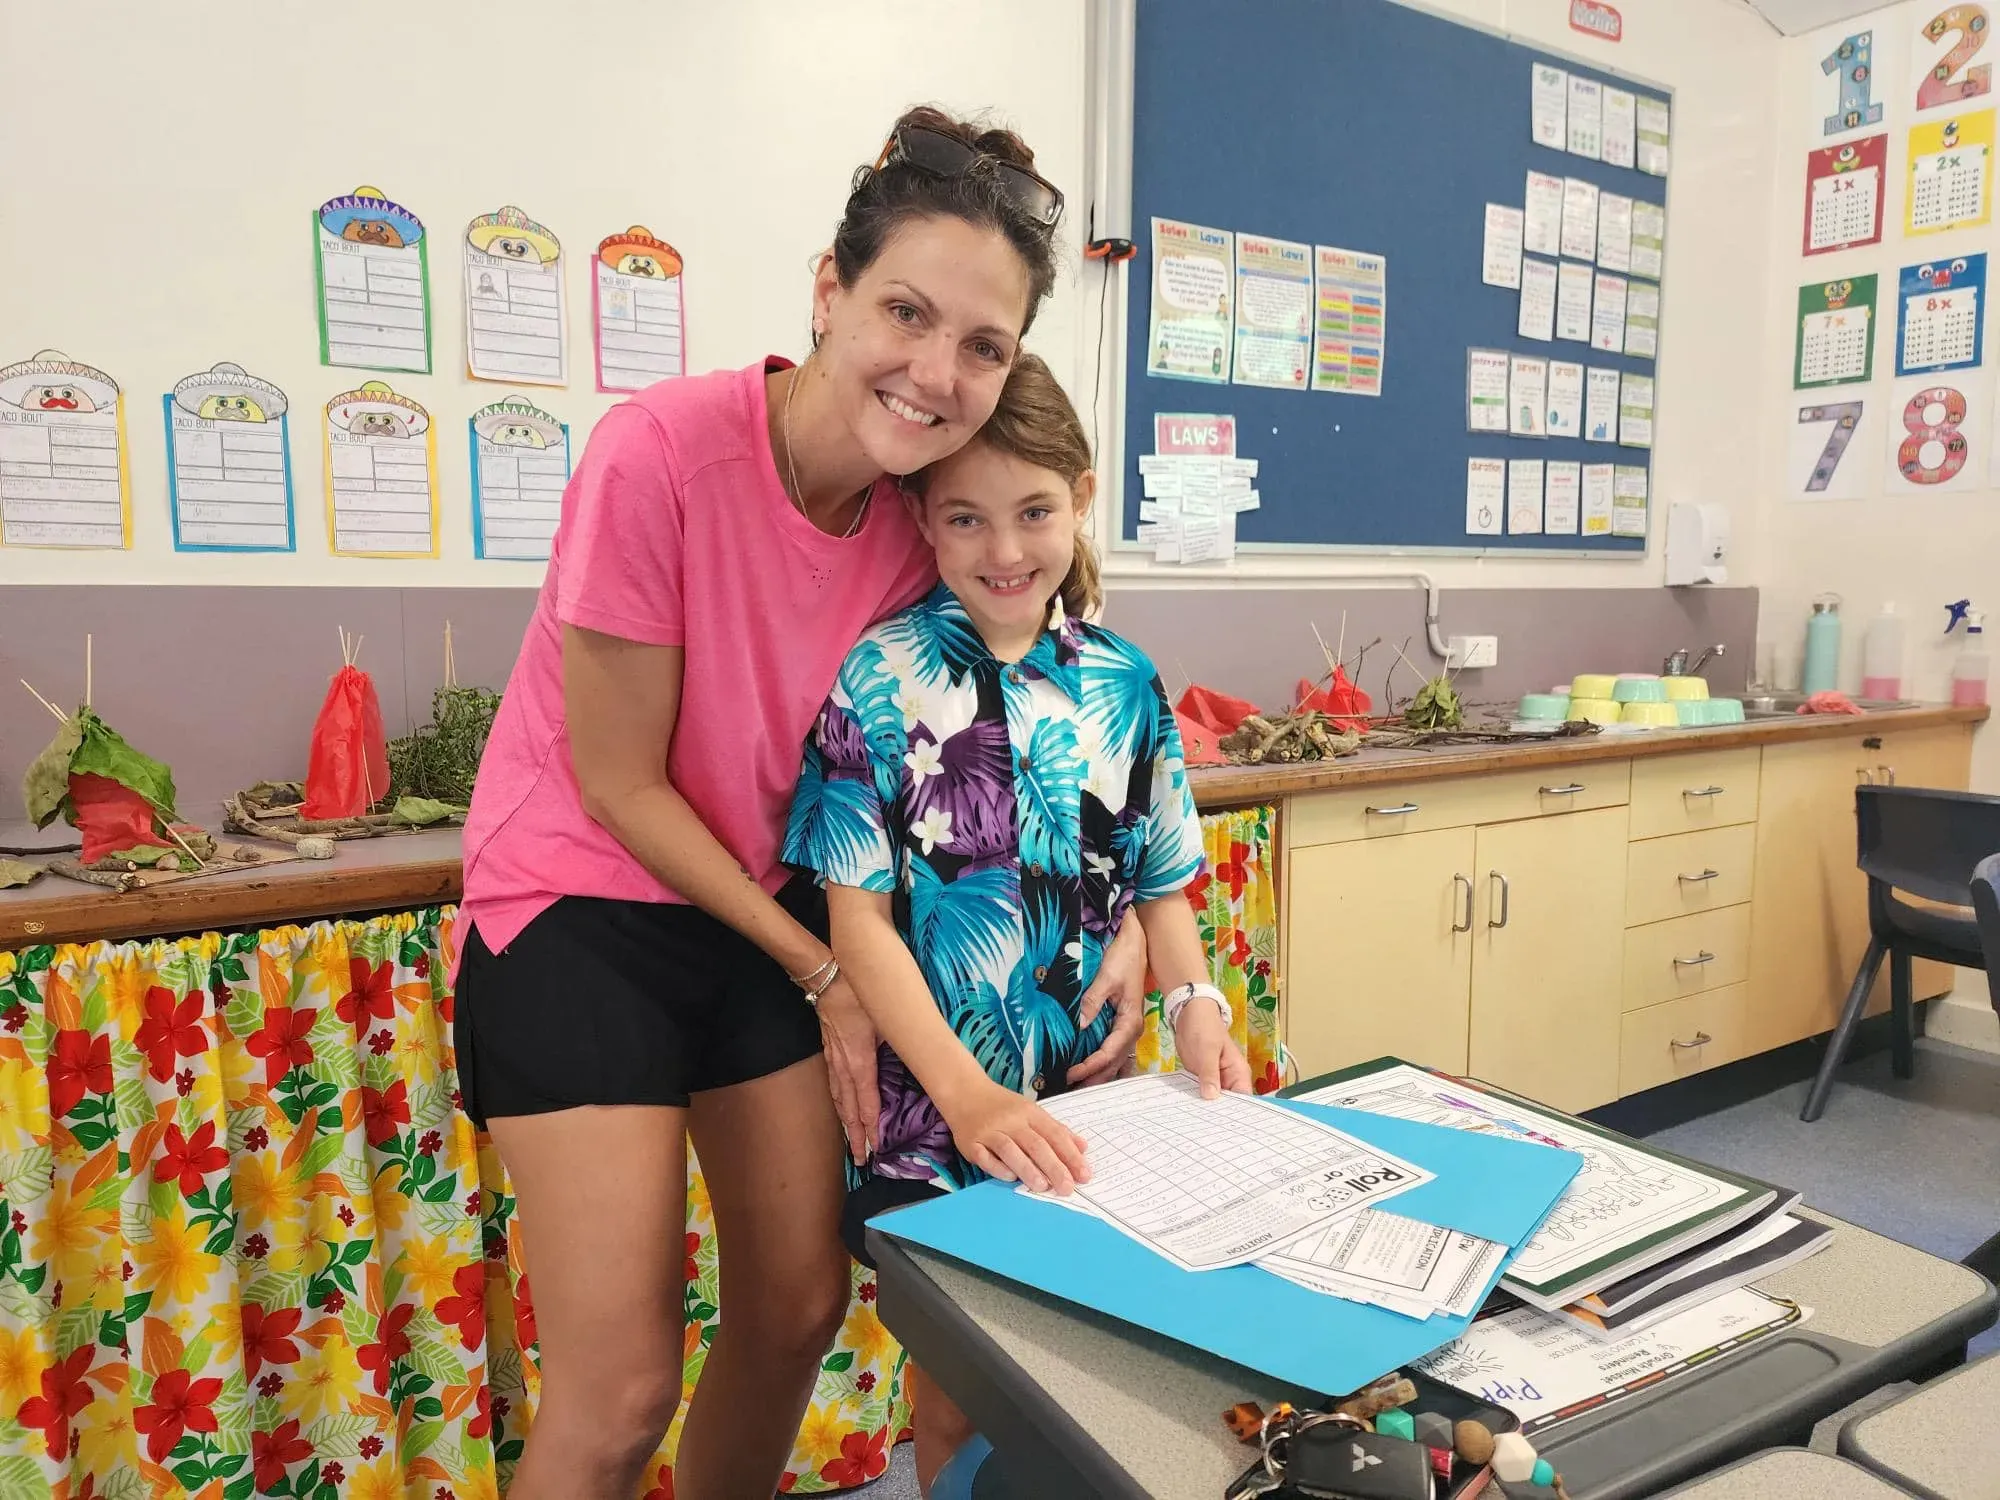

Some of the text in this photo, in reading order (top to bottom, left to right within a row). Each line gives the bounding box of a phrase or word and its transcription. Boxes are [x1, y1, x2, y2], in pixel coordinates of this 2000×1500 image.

[1916, 3, 1993, 111] 2
[1821, 29, 1884, 136] 1
[1200, 231, 1225, 245] Laws
[322, 240, 360, 255] TACO BOUT
[1280, 247, 1304, 261] Laws
[468, 254, 485, 265] TACO
[600, 276, 614, 286] TACO
[0, 412, 44, 423] ACO BOUT
[174, 418, 215, 429] TACO BOUT
[330, 432, 367, 443] TACO BOUT
[1172, 426, 1218, 446] LAWS
[1897, 386, 1968, 486] 8
[480, 444, 514, 454] TACO BOUT
[1798, 400, 1863, 493] 7
[1324, 1170, 1343, 1182] or
[1344, 1167, 1404, 1193] Roll
[1226, 1232, 1273, 1256] ADDITION
[1598, 1349, 1651, 1371] Reminders
[1601, 1352, 1675, 1384] Growth Mindset
